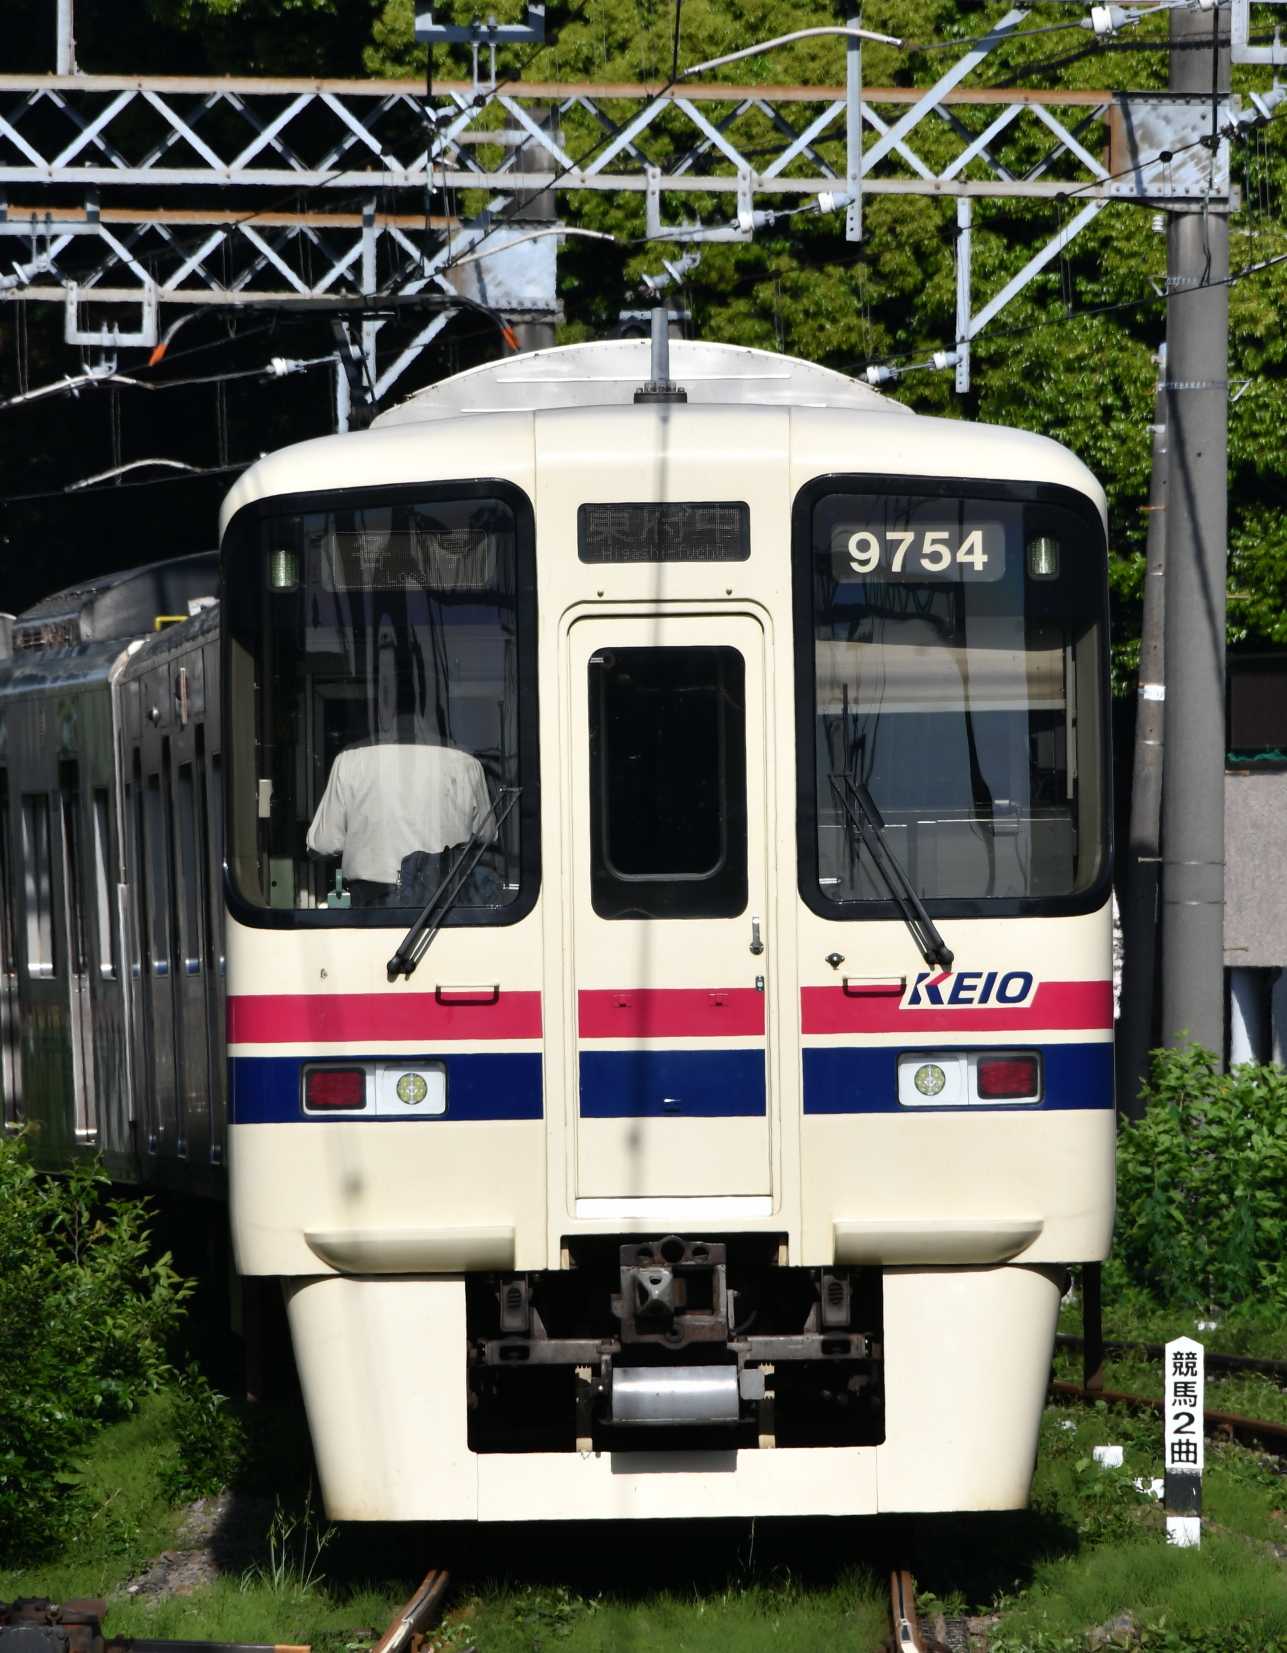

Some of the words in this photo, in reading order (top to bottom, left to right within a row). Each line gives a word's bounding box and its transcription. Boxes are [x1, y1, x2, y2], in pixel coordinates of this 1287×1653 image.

[847, 530, 988, 573] 9754
[908, 971, 1034, 1005] KEIO
[1171, 1351, 1198, 1464] 競馬2曲
